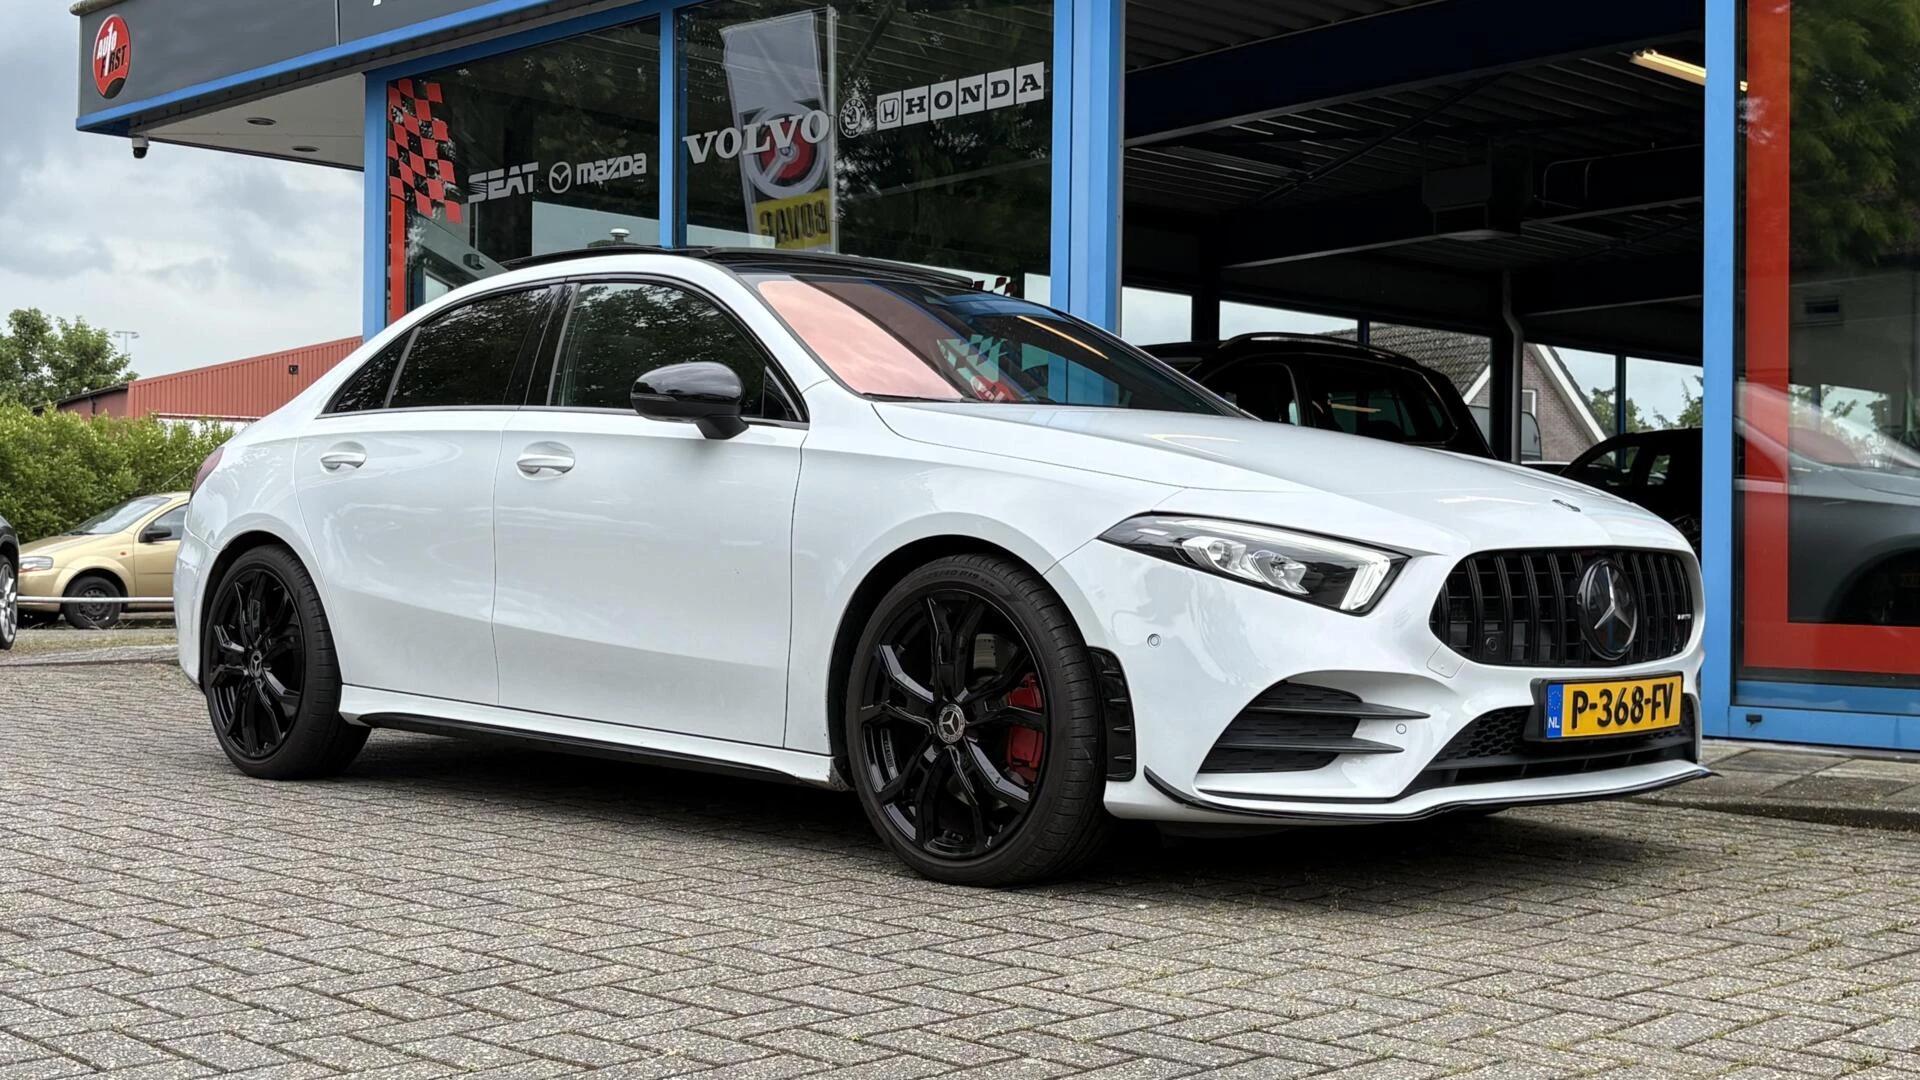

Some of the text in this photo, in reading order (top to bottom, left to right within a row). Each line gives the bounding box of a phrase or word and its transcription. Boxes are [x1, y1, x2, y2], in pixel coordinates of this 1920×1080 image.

[905, 73, 1042, 116] HONDA
[682, 110, 830, 164] VOLVO
[468, 162, 539, 203] SEAT
[1548, 716, 1560, 729] NL
[1571, 682, 1674, 730] P-368-FV
